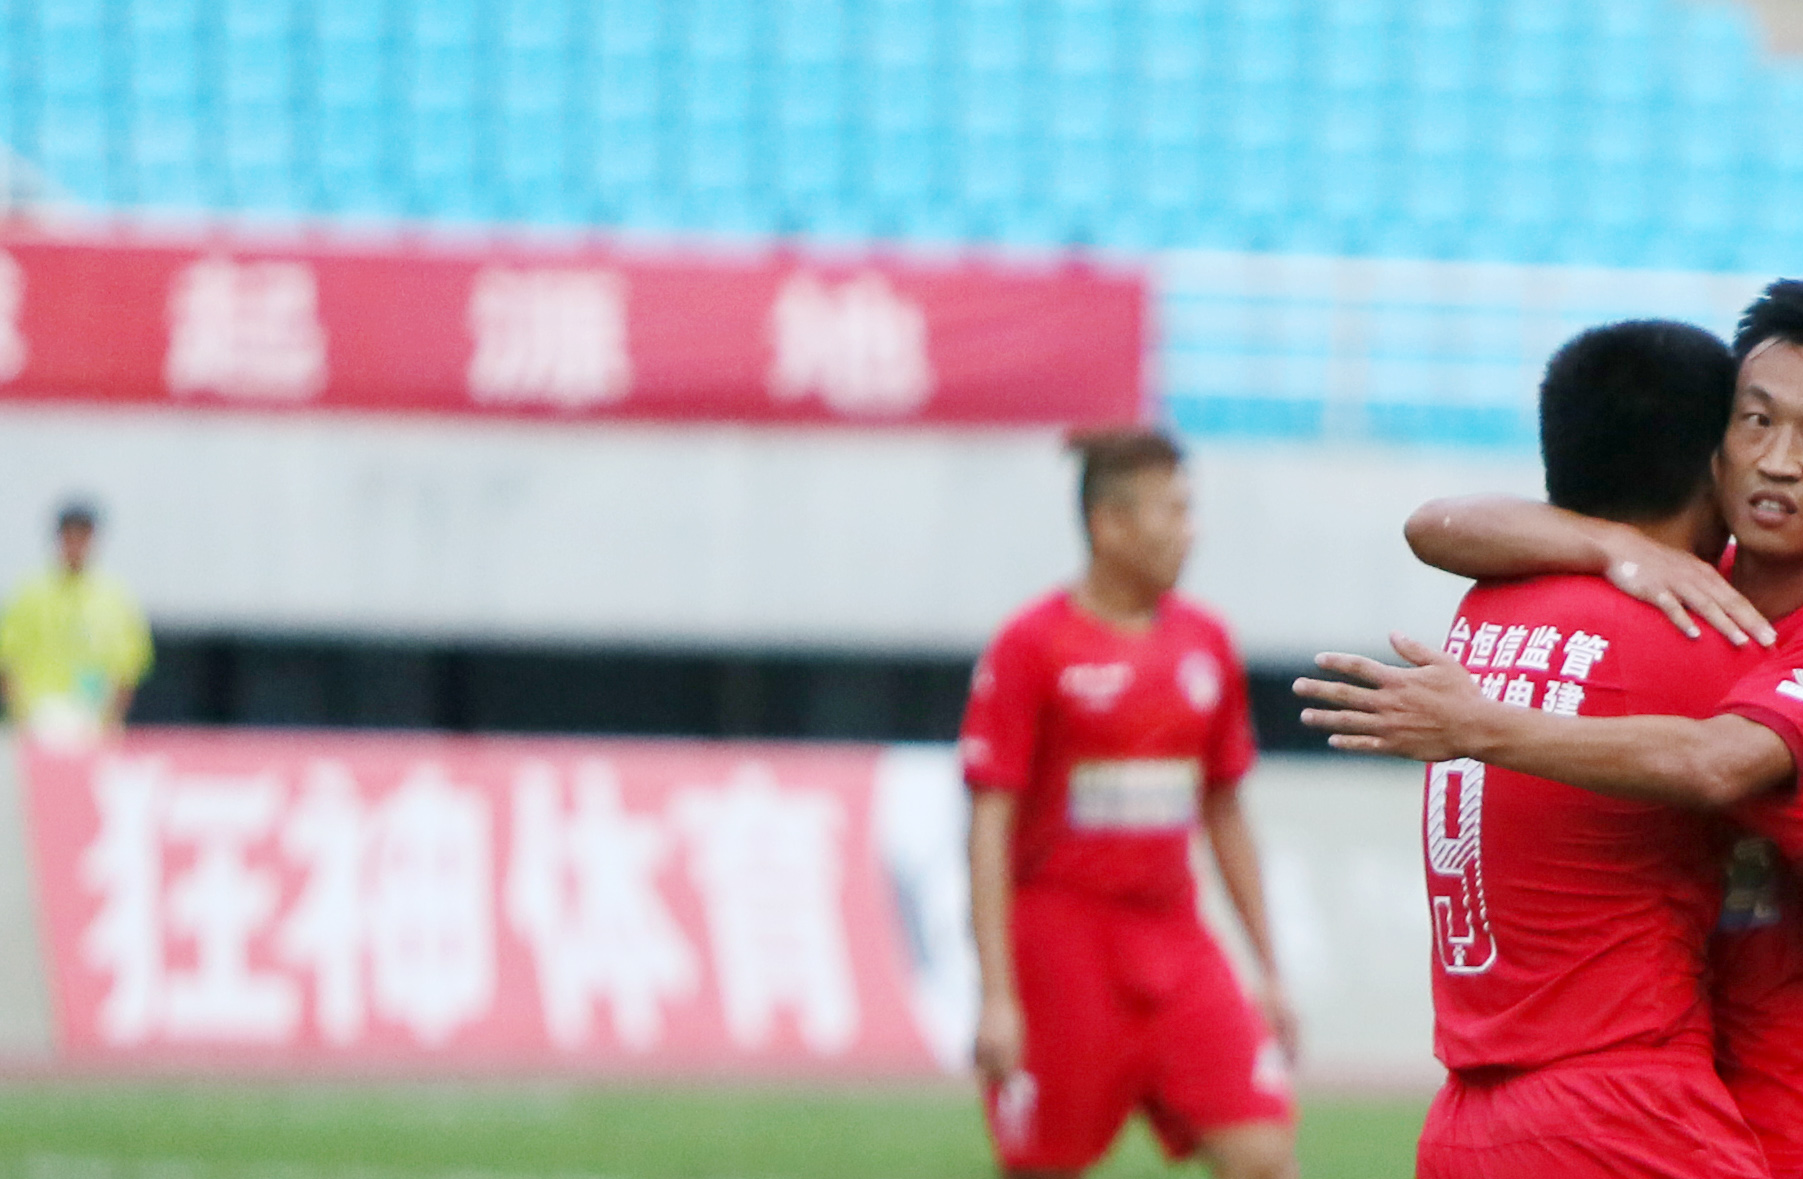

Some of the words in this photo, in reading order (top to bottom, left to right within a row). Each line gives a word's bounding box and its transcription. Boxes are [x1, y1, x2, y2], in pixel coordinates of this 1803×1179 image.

[0, 248, 937, 418] 起源地
[82, 755, 859, 1053] 狂神体育
[1428, 757, 1497, 974] 9
